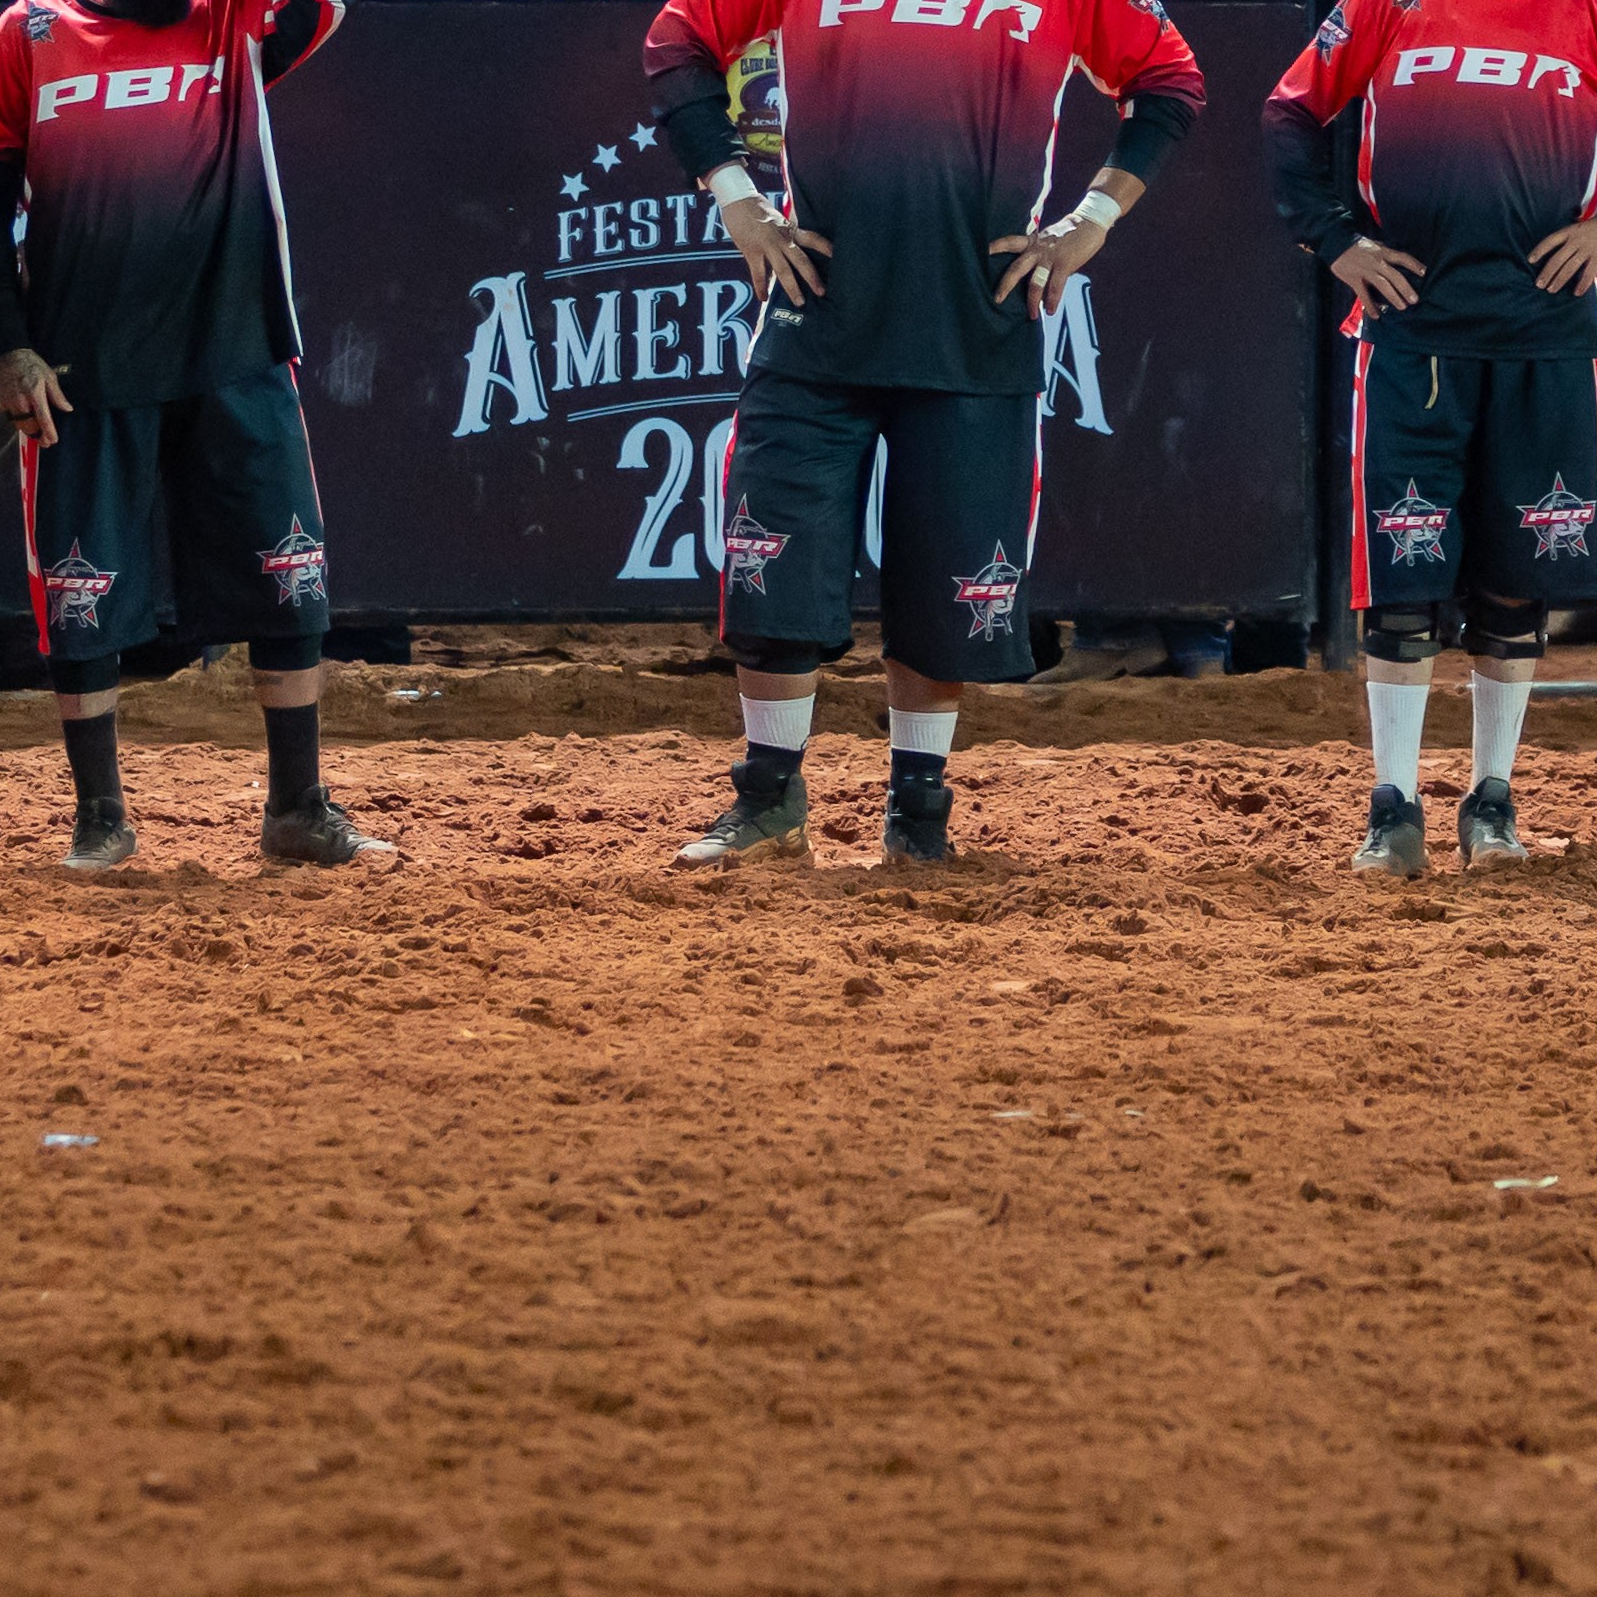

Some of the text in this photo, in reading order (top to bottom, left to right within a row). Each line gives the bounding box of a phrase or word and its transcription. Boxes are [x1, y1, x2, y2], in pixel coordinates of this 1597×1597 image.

[1392, 46, 1581, 98] PBR
[36, 56, 225, 124] PBR
[557, 192, 740, 263] FESTA
[452, 270, 1113, 438] AMERA
[1383, 515, 1443, 527] PBR
[1528, 508, 1592, 522] PBR
[268, 551, 323, 567] PBR
[46, 577, 108, 589] PBR
[964, 583, 1016, 596] PB
